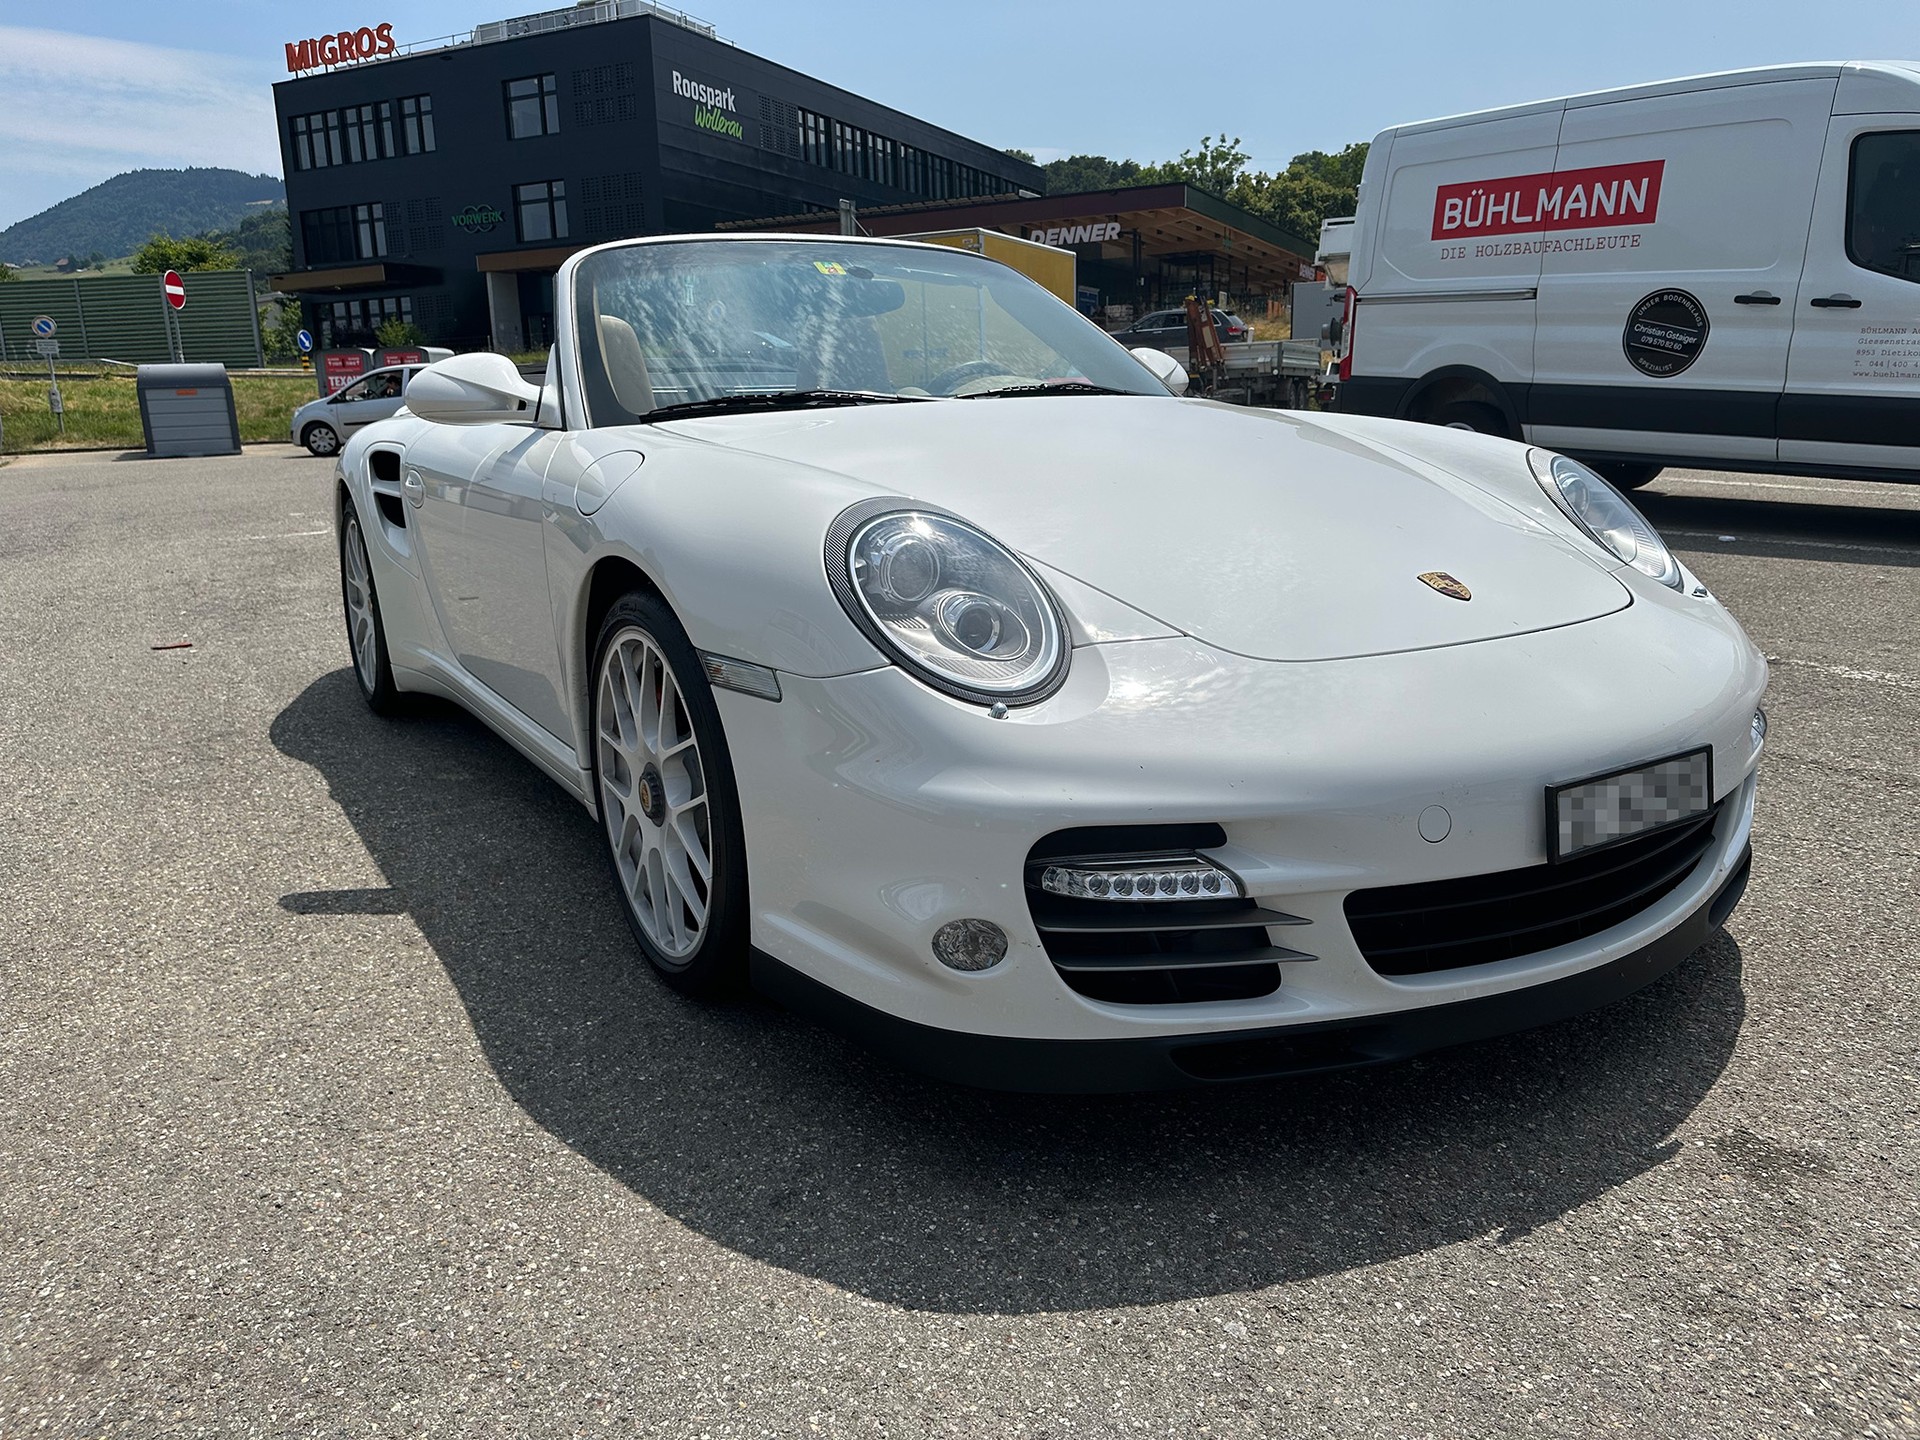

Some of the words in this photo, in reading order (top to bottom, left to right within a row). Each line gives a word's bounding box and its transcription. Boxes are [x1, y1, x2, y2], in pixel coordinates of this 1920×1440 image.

[284, 22, 395, 72] MIGROS
[672, 70, 736, 112] Roospark
[694, 104, 743, 140] Wollerau
[1442, 177, 1650, 230] BÜHLMANN
[451, 210, 504, 226] VORWERK
[1030, 222, 1121, 246] DENNER
[1441, 246, 1467, 260] DIE
[1475, 235, 1641, 257] HOLZBAUFACHLEUTE
[1637, 296, 1660, 316] UNSER
[1634, 324, 1665, 337] Christian
[1860, 327, 1907, 335] BÜHLMANN
[1641, 336, 1653, 344] 079
[1653, 338, 1665, 346] 570
[1880, 349, 1920, 357] Dietiko
[1639, 357, 1673, 371] SPEZIALIST
[328, 375, 359, 388] TEXA
